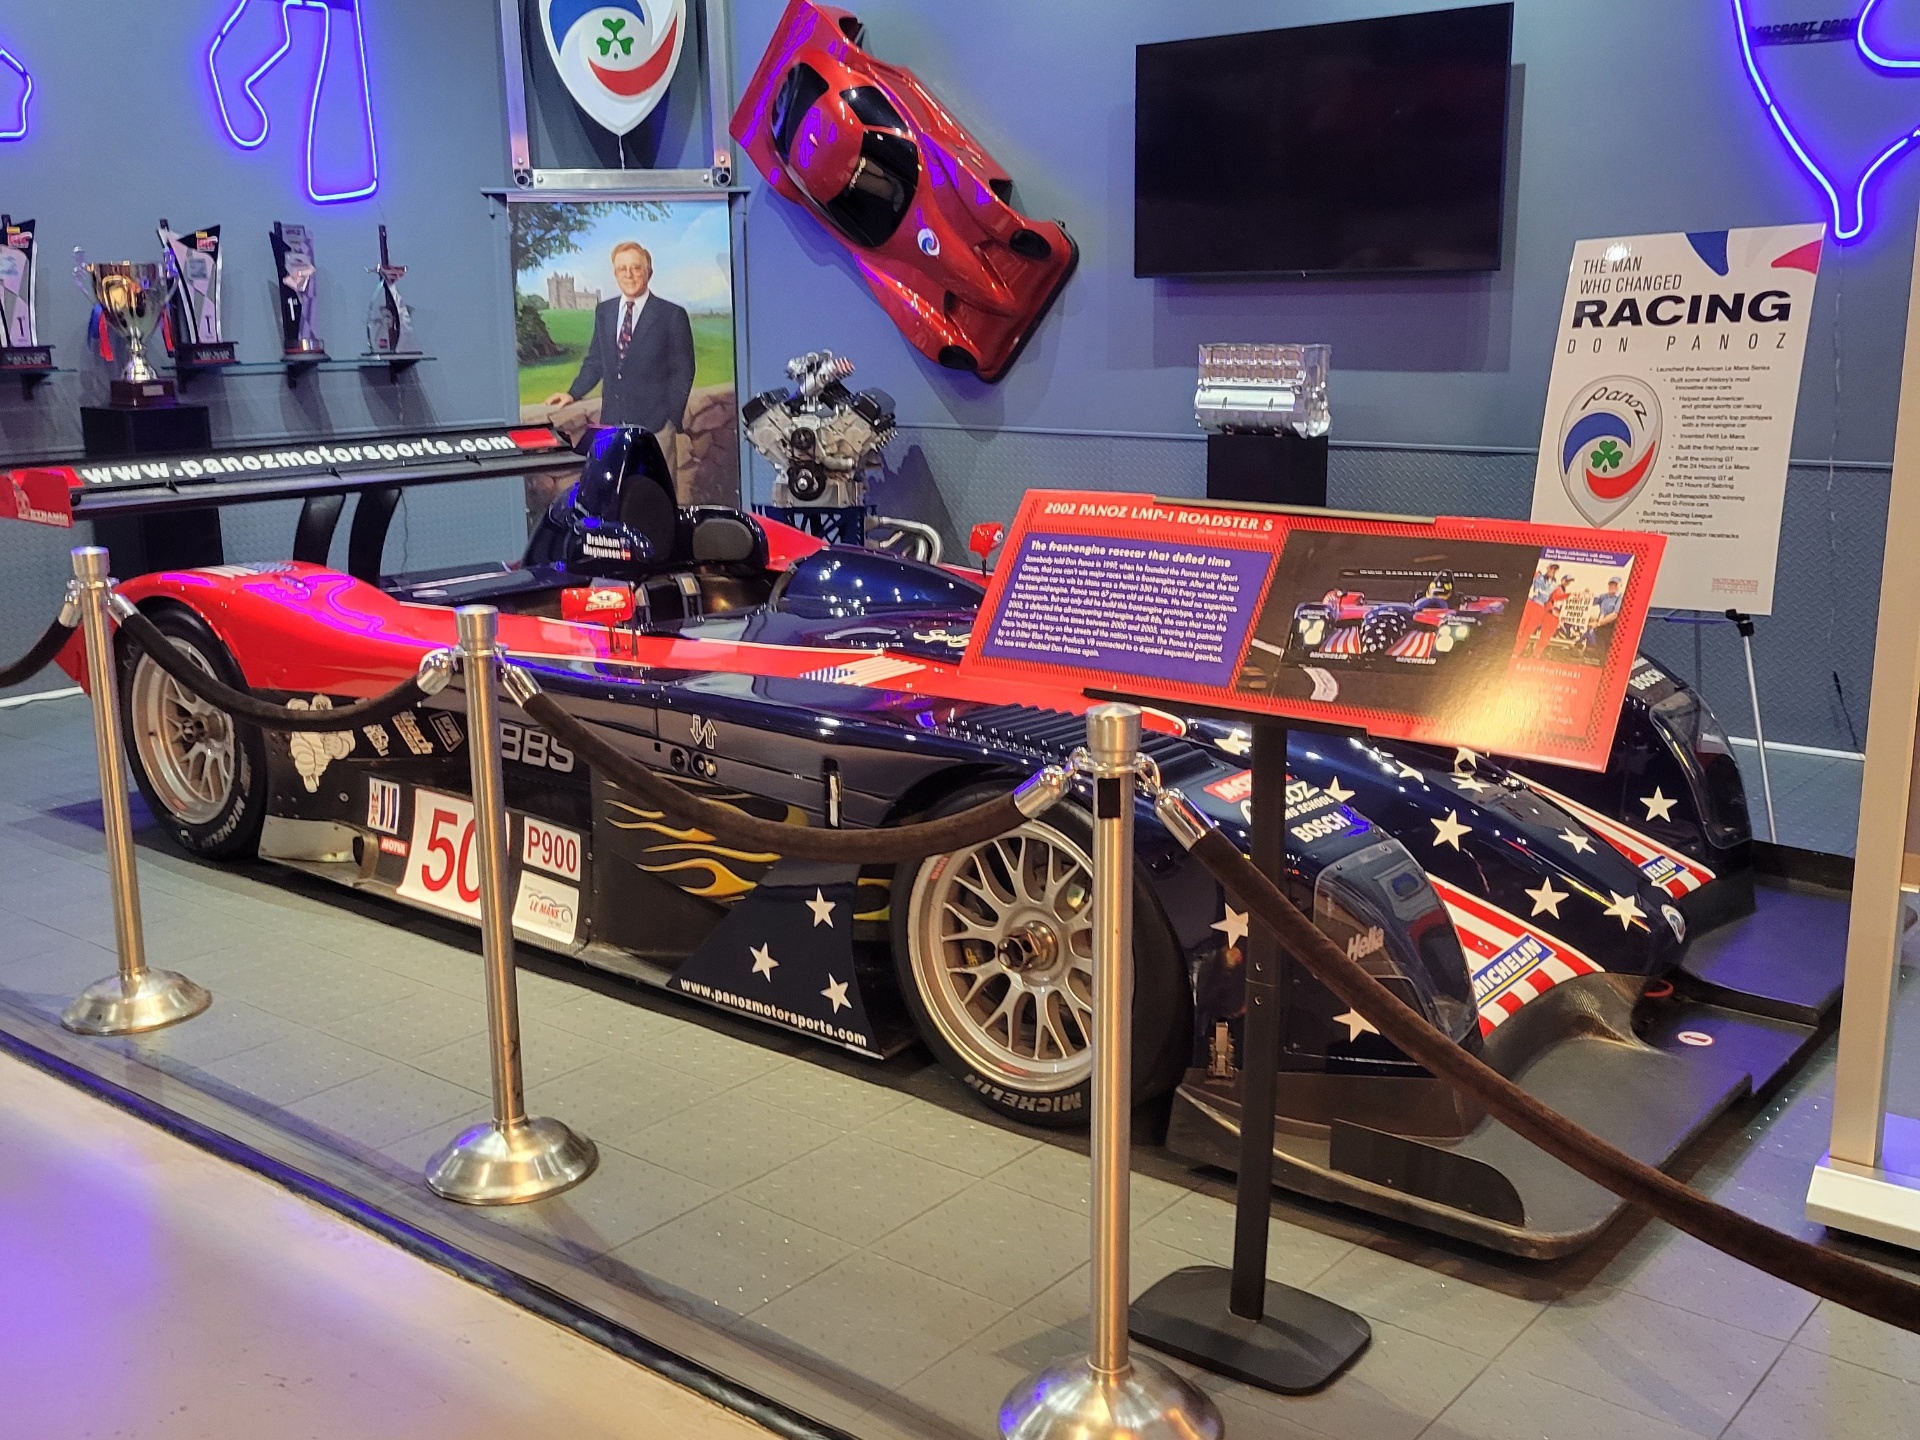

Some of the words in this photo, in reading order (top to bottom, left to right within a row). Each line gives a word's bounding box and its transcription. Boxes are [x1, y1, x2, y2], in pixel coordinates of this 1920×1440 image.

[1583, 258, 1607, 275] THE
[1611, 256, 1643, 273] MAN
[1580, 278, 1611, 294] WHO
[1615, 274, 1682, 293] CHANGED
[1571, 290, 1791, 329] RACING
[1567, 336, 1629, 354] DON
[1666, 332, 1786, 351] PANOZ
[1580, 386, 1647, 432] panoz
[81, 434, 516, 484] www.panozmotorsports.com
[1043, 501, 1076, 516] 2002
[1078, 503, 1129, 519] PANOZ
[1131, 505, 1175, 522] LMP-1
[1177, 508, 1259, 530] ROADSTER
[1262, 518, 1274, 532] S
[586, 532, 621, 548] Brabham
[1031, 541, 1047, 550] The
[1049, 541, 1106, 556] front-engine
[1108, 548, 1146, 558] racecar
[1148, 550, 1169, 560] that
[1172, 552, 1206, 564] defied
[1207, 556, 1232, 567] time
[1396, 656, 1437, 665] MICHELIN
[1629, 667, 1666, 691] BOSCH
[371, 782, 379, 826] IMSA
[1297, 794, 1335, 815] SCHOOL
[1290, 811, 1351, 844] BOSCH
[381, 836, 407, 855] MOTUL
[527, 825, 578, 874] P900
[530, 900, 539, 912] LE
[539, 903, 560, 920] MANS
[1346, 925, 1385, 962] Hella
[1473, 937, 1544, 999] MICHELIN
[679, 977, 868, 1048] www.panozmotorsports.com
[963, 1073, 1082, 1113] MICHELIN
